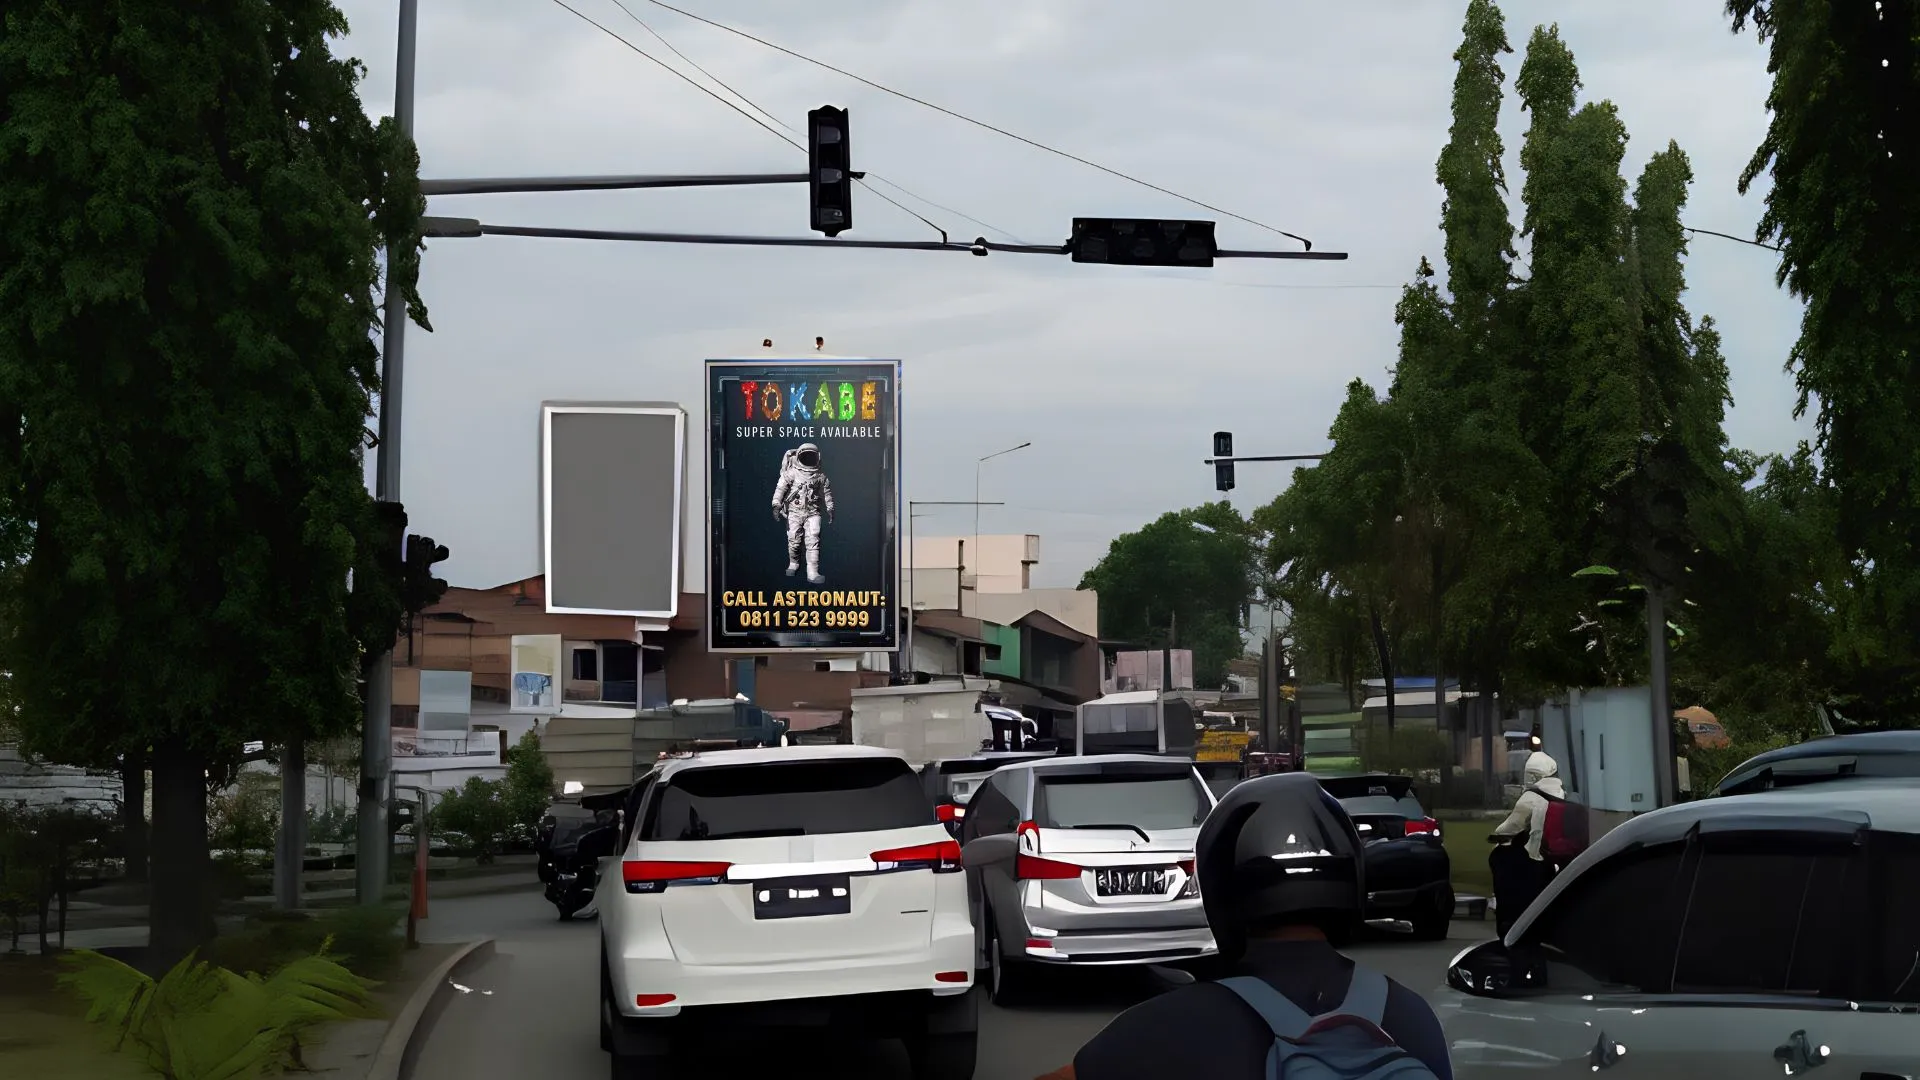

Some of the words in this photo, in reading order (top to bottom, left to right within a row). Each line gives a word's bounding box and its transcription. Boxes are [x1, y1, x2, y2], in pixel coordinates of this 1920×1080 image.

[740, 381, 877, 421] TOKABE
[736, 426, 773, 438] SUPER
[779, 426, 815, 438] SPACE
[820, 426, 881, 438] AVAILABLE
[722, 590, 768, 607] CALL
[772, 590, 886, 607] ASTRONAUT:
[739, 610, 781, 627] 0811
[787, 610, 820, 627] 523
[825, 610, 869, 627] 9999
